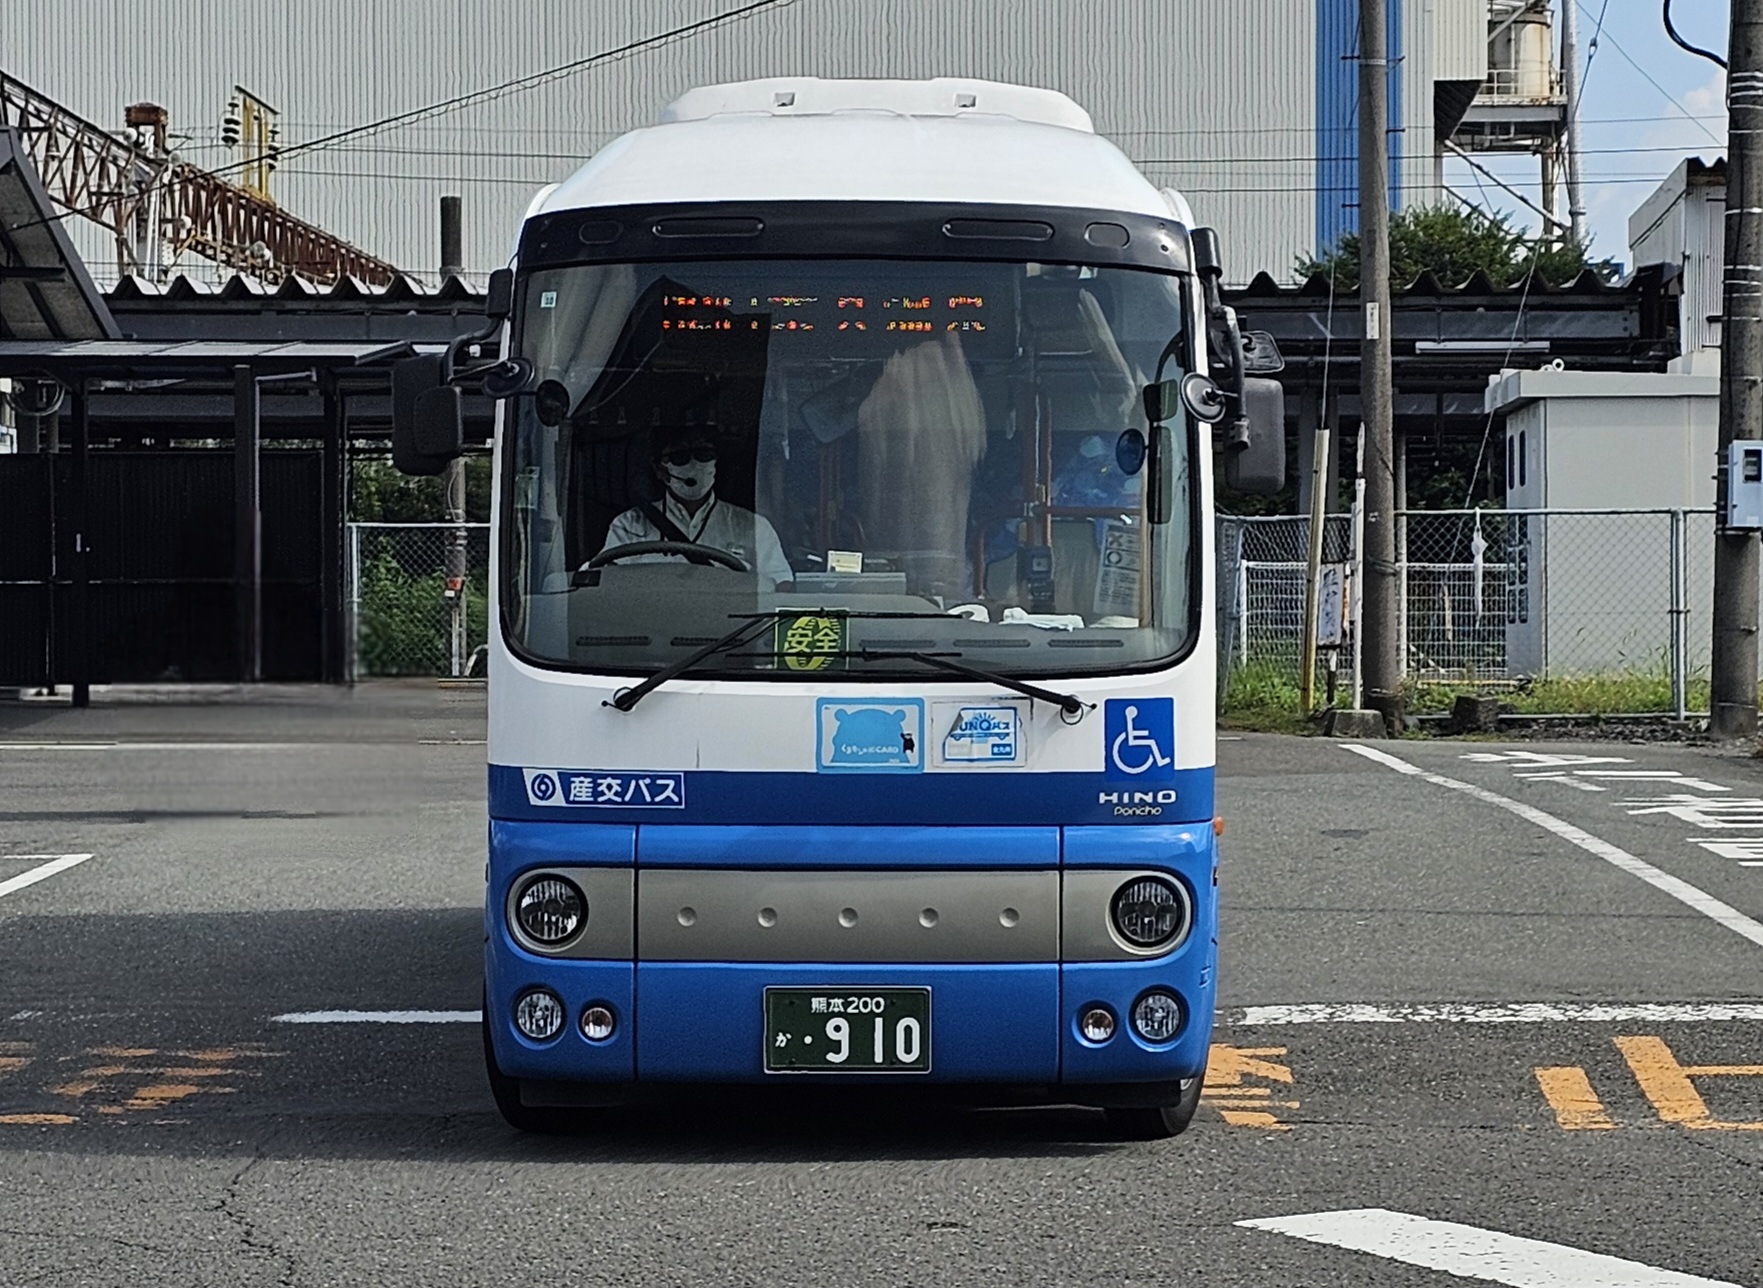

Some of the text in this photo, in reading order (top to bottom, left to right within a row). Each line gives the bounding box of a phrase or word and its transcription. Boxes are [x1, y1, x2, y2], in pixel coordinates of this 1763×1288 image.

[783, 628, 839, 653] 安全
[569, 776, 680, 803] 産交バス
[1098, 790, 1177, 804] HINO
